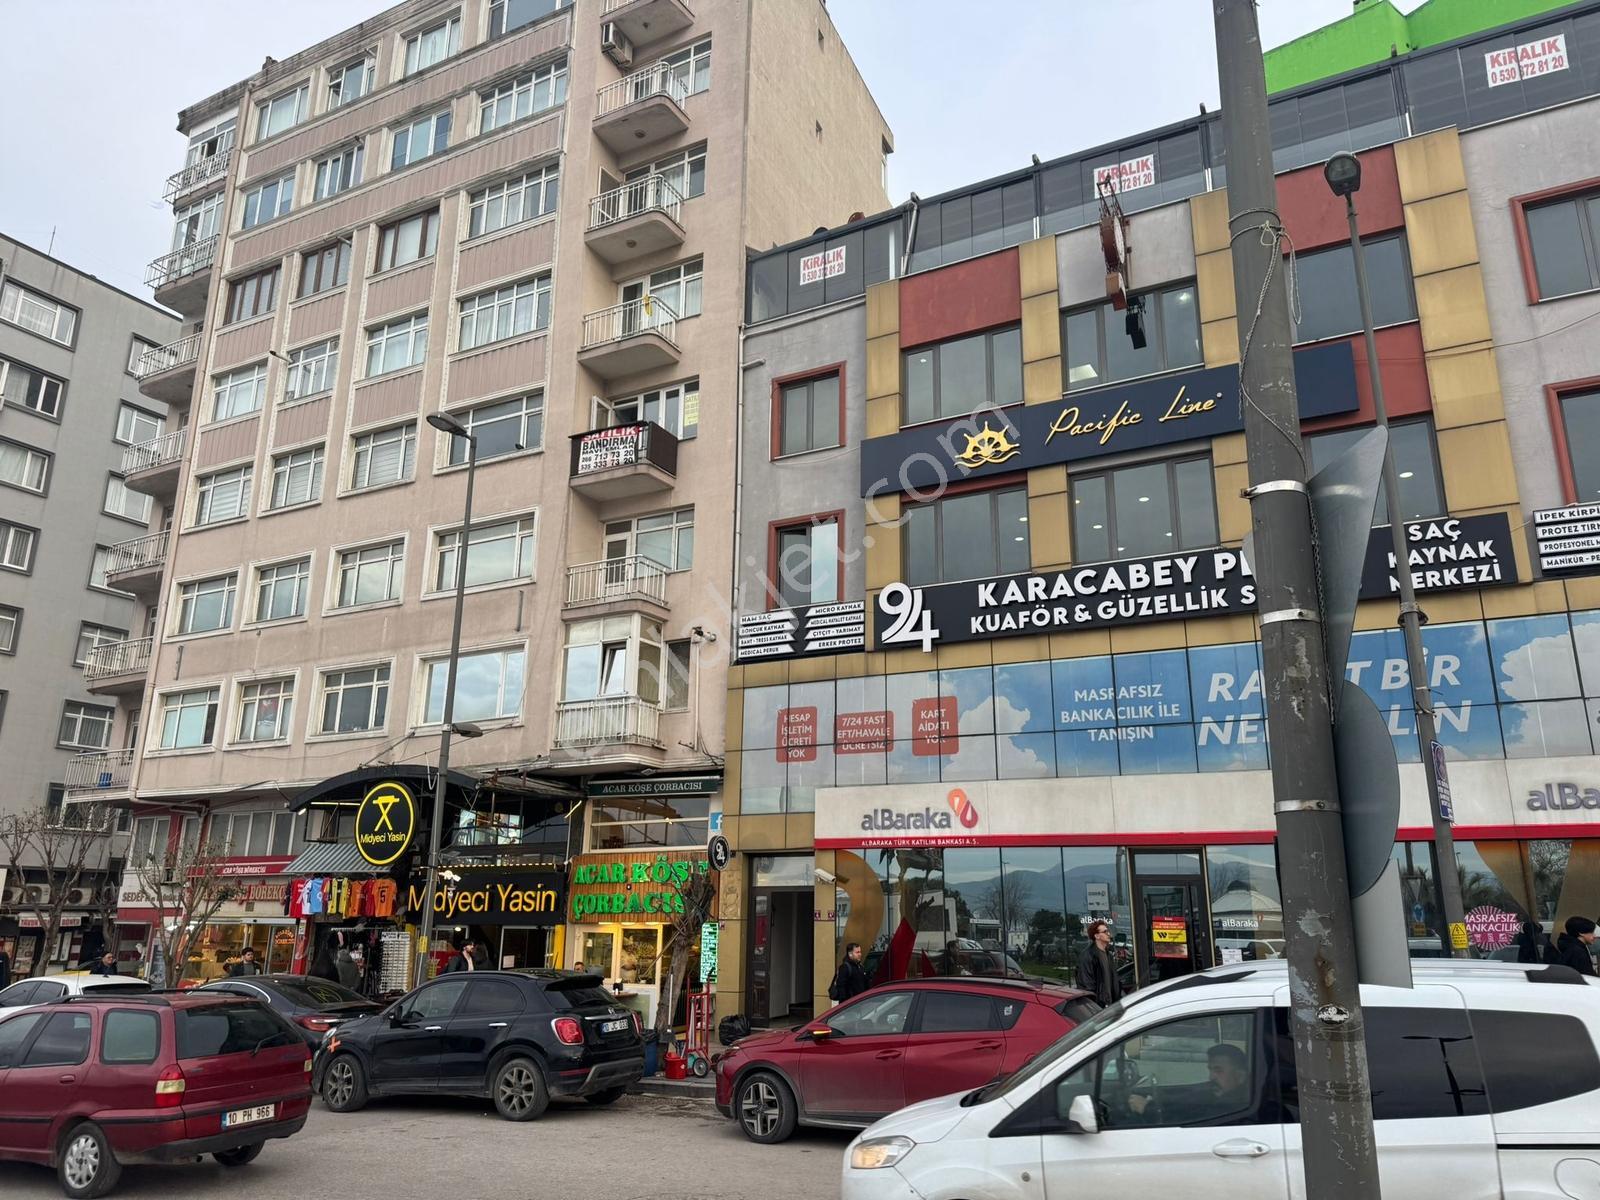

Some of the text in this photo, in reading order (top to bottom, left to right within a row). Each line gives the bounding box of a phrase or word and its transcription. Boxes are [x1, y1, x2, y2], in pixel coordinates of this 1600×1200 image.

[1491, 72, 1497, 84] 0
[1500, 68, 1516, 81] 530
[1540, 60, 1549, 73] 81
[1552, 56, 1564, 69] 20
[1133, 176, 1140, 187] 81
[1143, 173, 1152, 185] 20
[1044, 386, 1216, 445] Pacific Line
[583, 436, 634, 450] BANDIRMA
[1408, 520, 1462, 542] SAÇ
[1542, 525, 1579, 536] PROTEZ
[1544, 540, 1594, 550] PROFESYONEL
[1388, 540, 1496, 568] KAYNAK
[978, 556, 1198, 608] KARACABEY
[971, 605, 1069, 633] KUAFÖR
[1074, 606, 1092, 622] &
[1097, 585, 1229, 618] GÜZELLİK
[1074, 684, 1163, 702] MASRAFSIZ
[783, 713, 811, 723] HESAP
[920, 708, 946, 719] KART
[1061, 701, 1181, 723] BANKACILIK İLE
[842, 715, 885, 727] 7/24 FAST
[918, 720, 950, 732] AİDATI
[781, 724, 812, 735] İŞLETİM
[837, 728, 890, 738] EFT/HAVALE
[1088, 726, 1154, 743] TANIŞIN
[782, 735, 812, 746] ÜCRETİ
[842, 740, 885, 750] ÜCRETSİZ
[787, 749, 805, 758] YOK
[602, 785, 626, 793] ACAR
[654, 782, 702, 792] ÇORBACISI
[861, 807, 951, 831] alBaraka
[361, 832, 406, 845] Midyeci Yasin
[575, 864, 626, 884] ACAR
[407, 884, 557, 918] Mdyeci Yasin
[573, 892, 686, 920] ÇORBACIS
[1223, 919, 1259, 928] alBaraka
[1466, 923, 1520, 932] ANKACILIK
[229, 1107, 270, 1124] 10 PH 966
